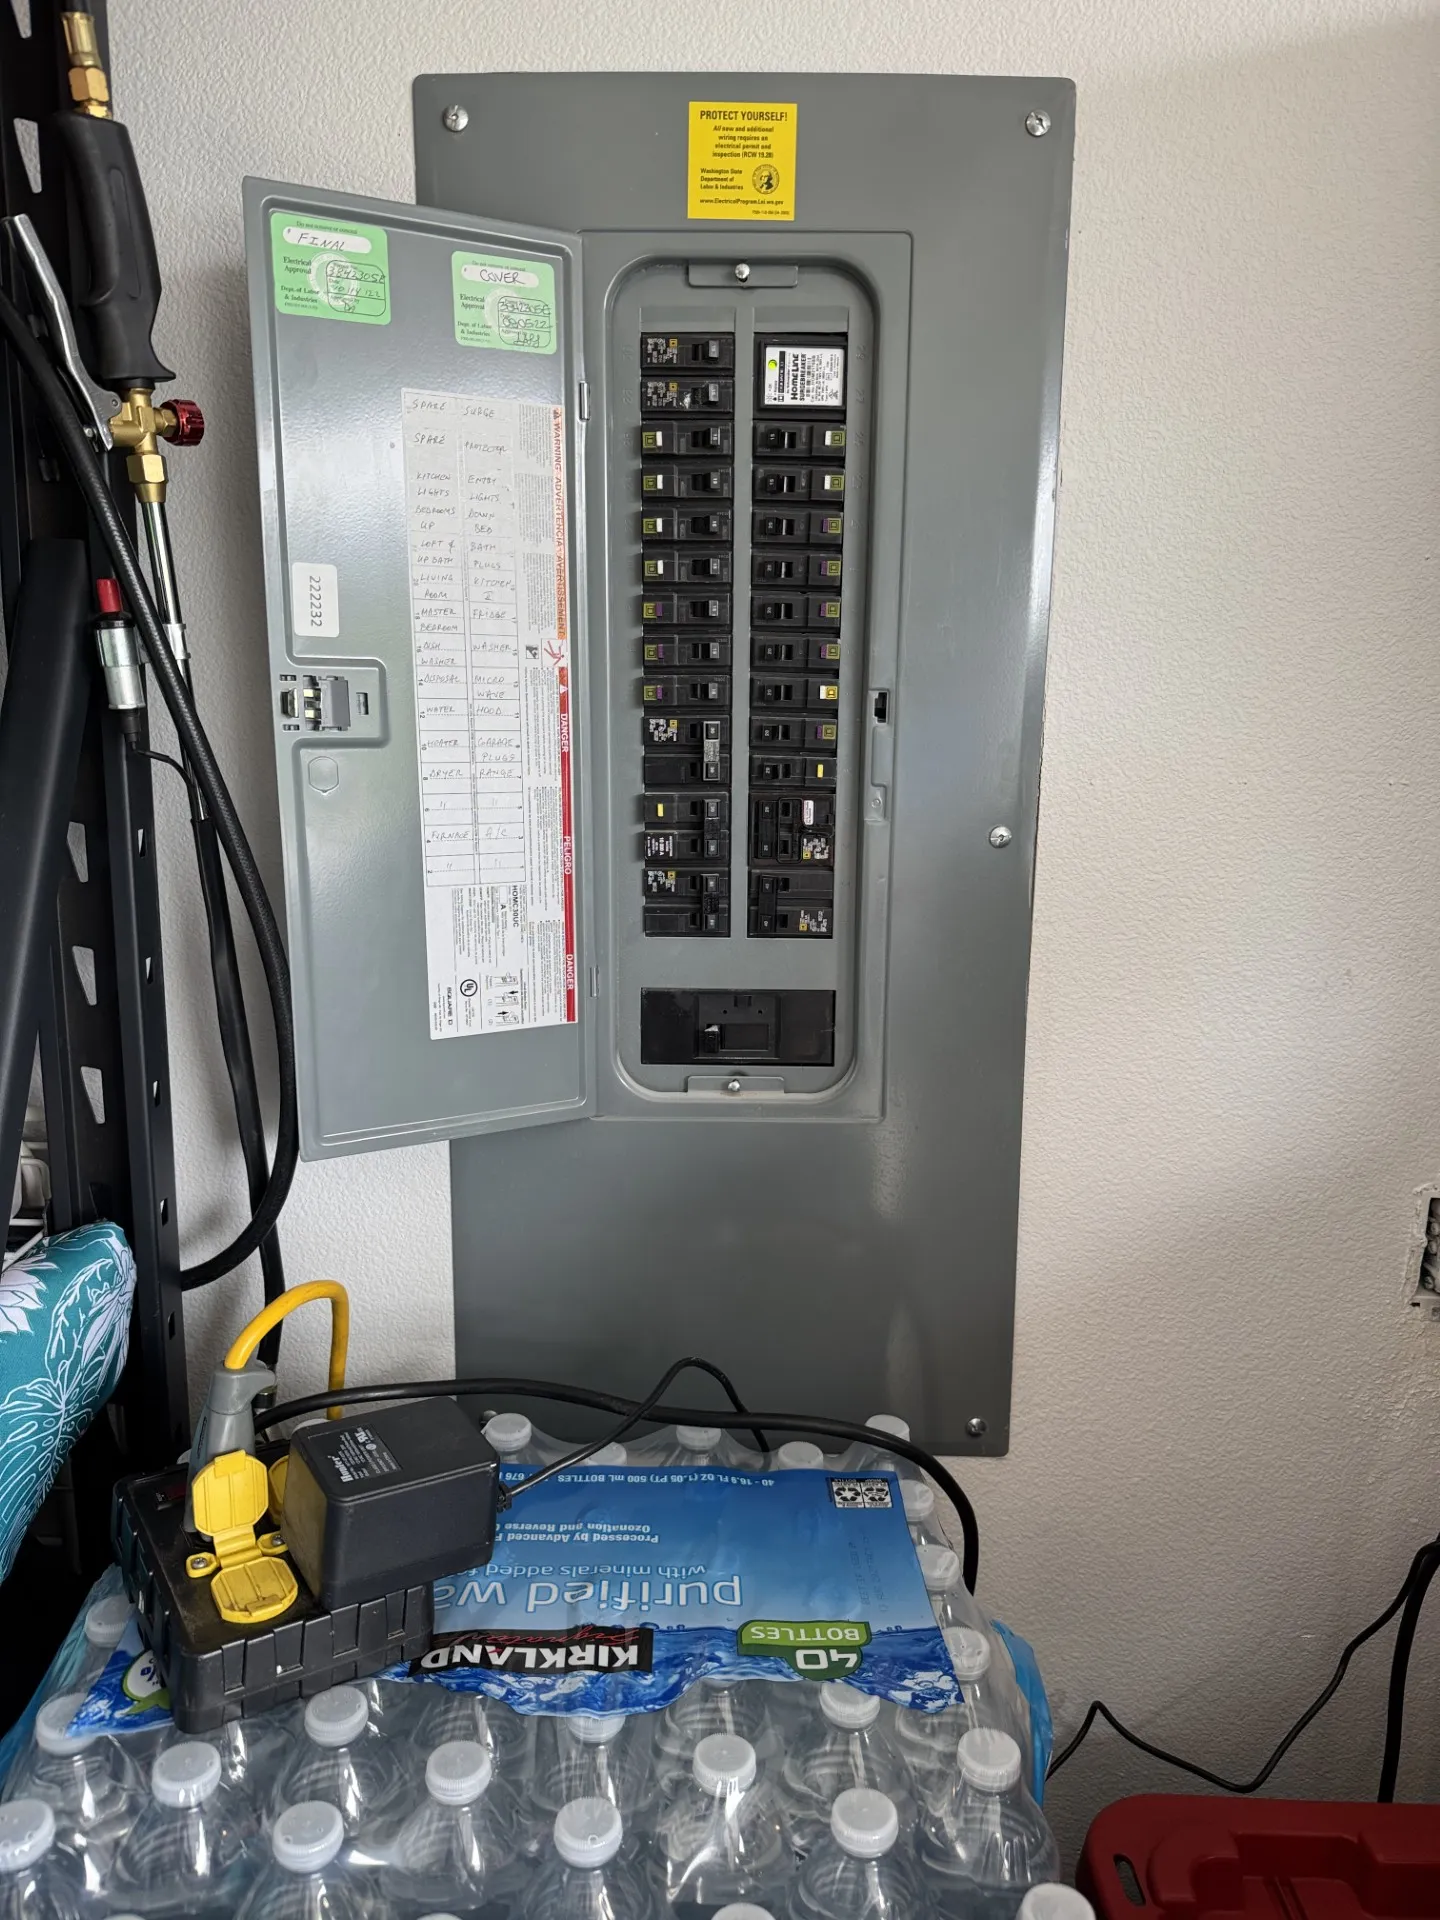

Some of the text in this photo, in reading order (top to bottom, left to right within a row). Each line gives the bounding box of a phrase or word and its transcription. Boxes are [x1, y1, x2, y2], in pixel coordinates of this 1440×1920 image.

[700, 110, 788, 122] PROTECT YOURSELF!
[298, 233, 345, 252] FINAL
[283, 256, 311, 266] Electrical
[284, 265, 311, 274] Approval
[480, 269, 526, 284] COVER
[291, 295, 318, 303] Industries
[460, 294, 485, 302] Electrical
[461, 302, 485, 310] Approval
[412, 399, 447, 411] SPARE
[464, 407, 495, 418] SURGE
[414, 433, 446, 444] SPARE
[417, 472, 451, 480] KITCHEN
[417, 488, 449, 496] LIGHTS
[420, 521, 435, 529] UP
[475, 524, 492, 534] BED
[553, 422, 565, 635] WARNING ADVERTENCIA AVERTISSEMENT
[470, 542, 496, 550] BATH
[432, 556, 453, 564] BATH
[473, 560, 501, 569] PLUGS
[420, 573, 453, 581] LIVING
[424, 590, 447, 599] ROOM
[309, 576, 322, 626] 222232
[472, 609, 506, 619] FRIDGE
[476, 706, 502, 715] HOOD
[427, 739, 458, 747] HEATER
[477, 738, 513, 747] GARAGE
[482, 752, 516, 762] PLUGS
[430, 770, 463, 778] DRYER
[479, 770, 514, 779] RANGE
[485, 827, 507, 837] A/C
[564, 836, 572, 874] PELIGRO
[566, 954, 574, 990] DANGER
[464, 983, 474, 992] UL
[505, 1472, 525, 1481] 676
[558, 1474, 605, 1483] BOTTLES
[628, 1475, 647, 1483] 500
[650, 1474, 667, 1483] PT)
[670, 1473, 698, 1483] (1.05
[700, 1473, 715, 1481] OZ
[717, 1474, 729, 1482] FL
[731, 1476, 752, 1485] 16.9
[505, 1523, 650, 1533] Ozonation and Reverse
[507, 1532, 659, 1543] Processed by Advanced
[485, 1563, 553, 1578] added
[559, 1565, 651, 1578] minerals
[657, 1564, 706, 1580] with
[526, 1575, 742, 1613] purified
[751, 1626, 860, 1641] BOTTLES
[421, 1645, 638, 1668] KIRKLAND
[796, 1648, 858, 1670] 40
